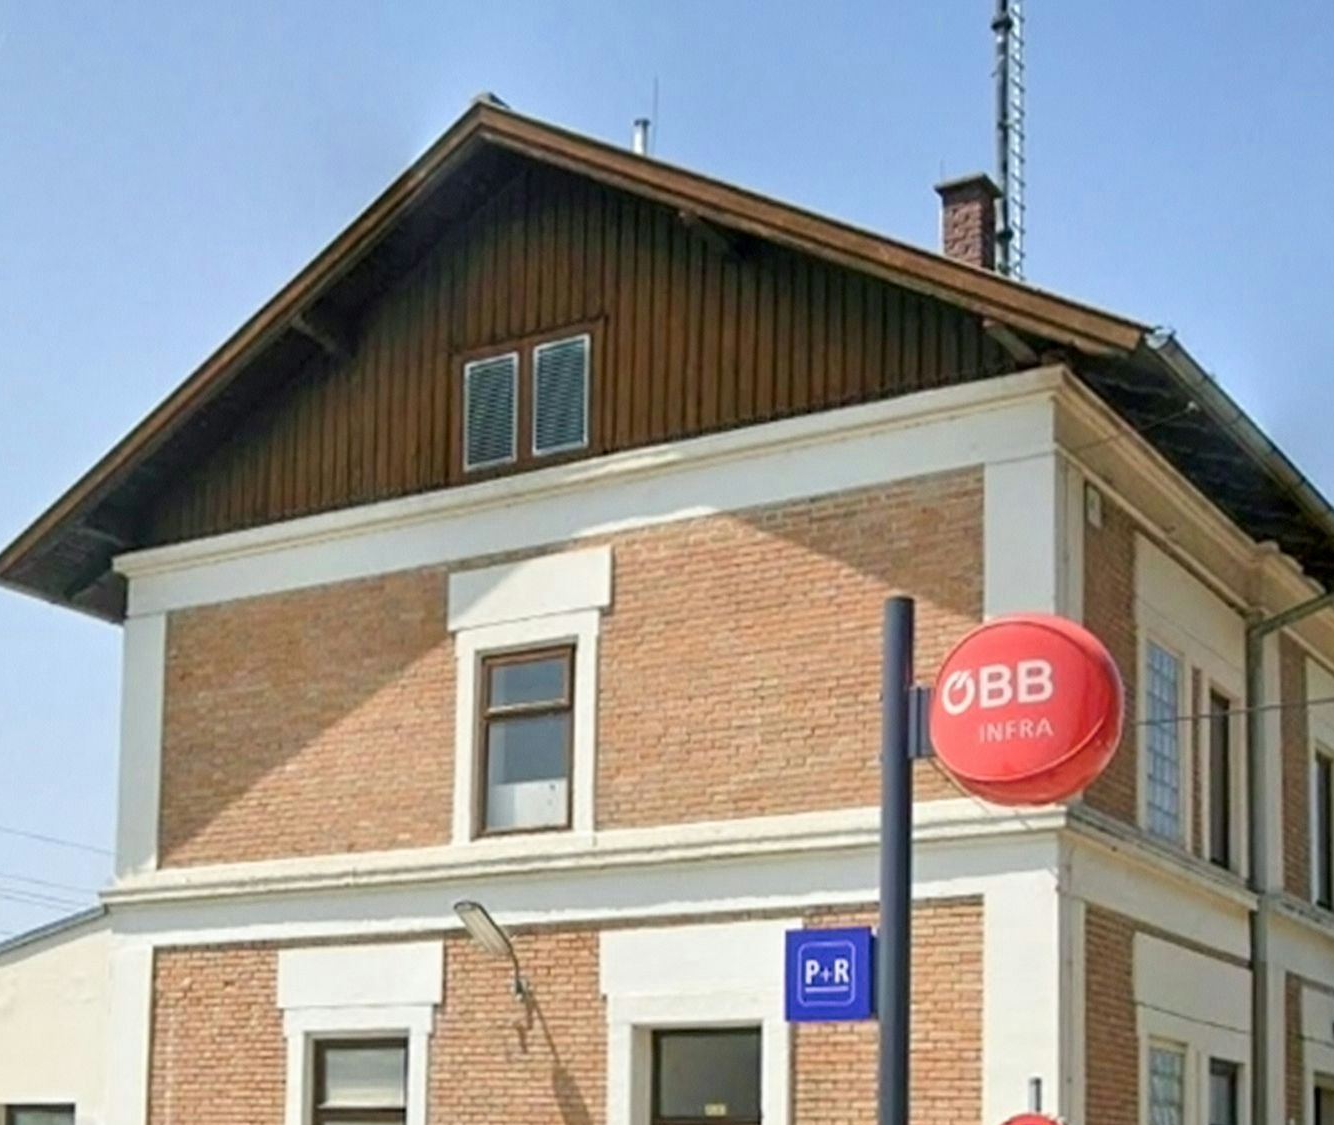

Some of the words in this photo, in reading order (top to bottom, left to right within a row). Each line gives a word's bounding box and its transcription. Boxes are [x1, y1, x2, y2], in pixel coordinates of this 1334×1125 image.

[942, 660, 1054, 716] ÖBB
[979, 718, 1055, 744] INFRA
[805, 958, 849, 985] P+R
